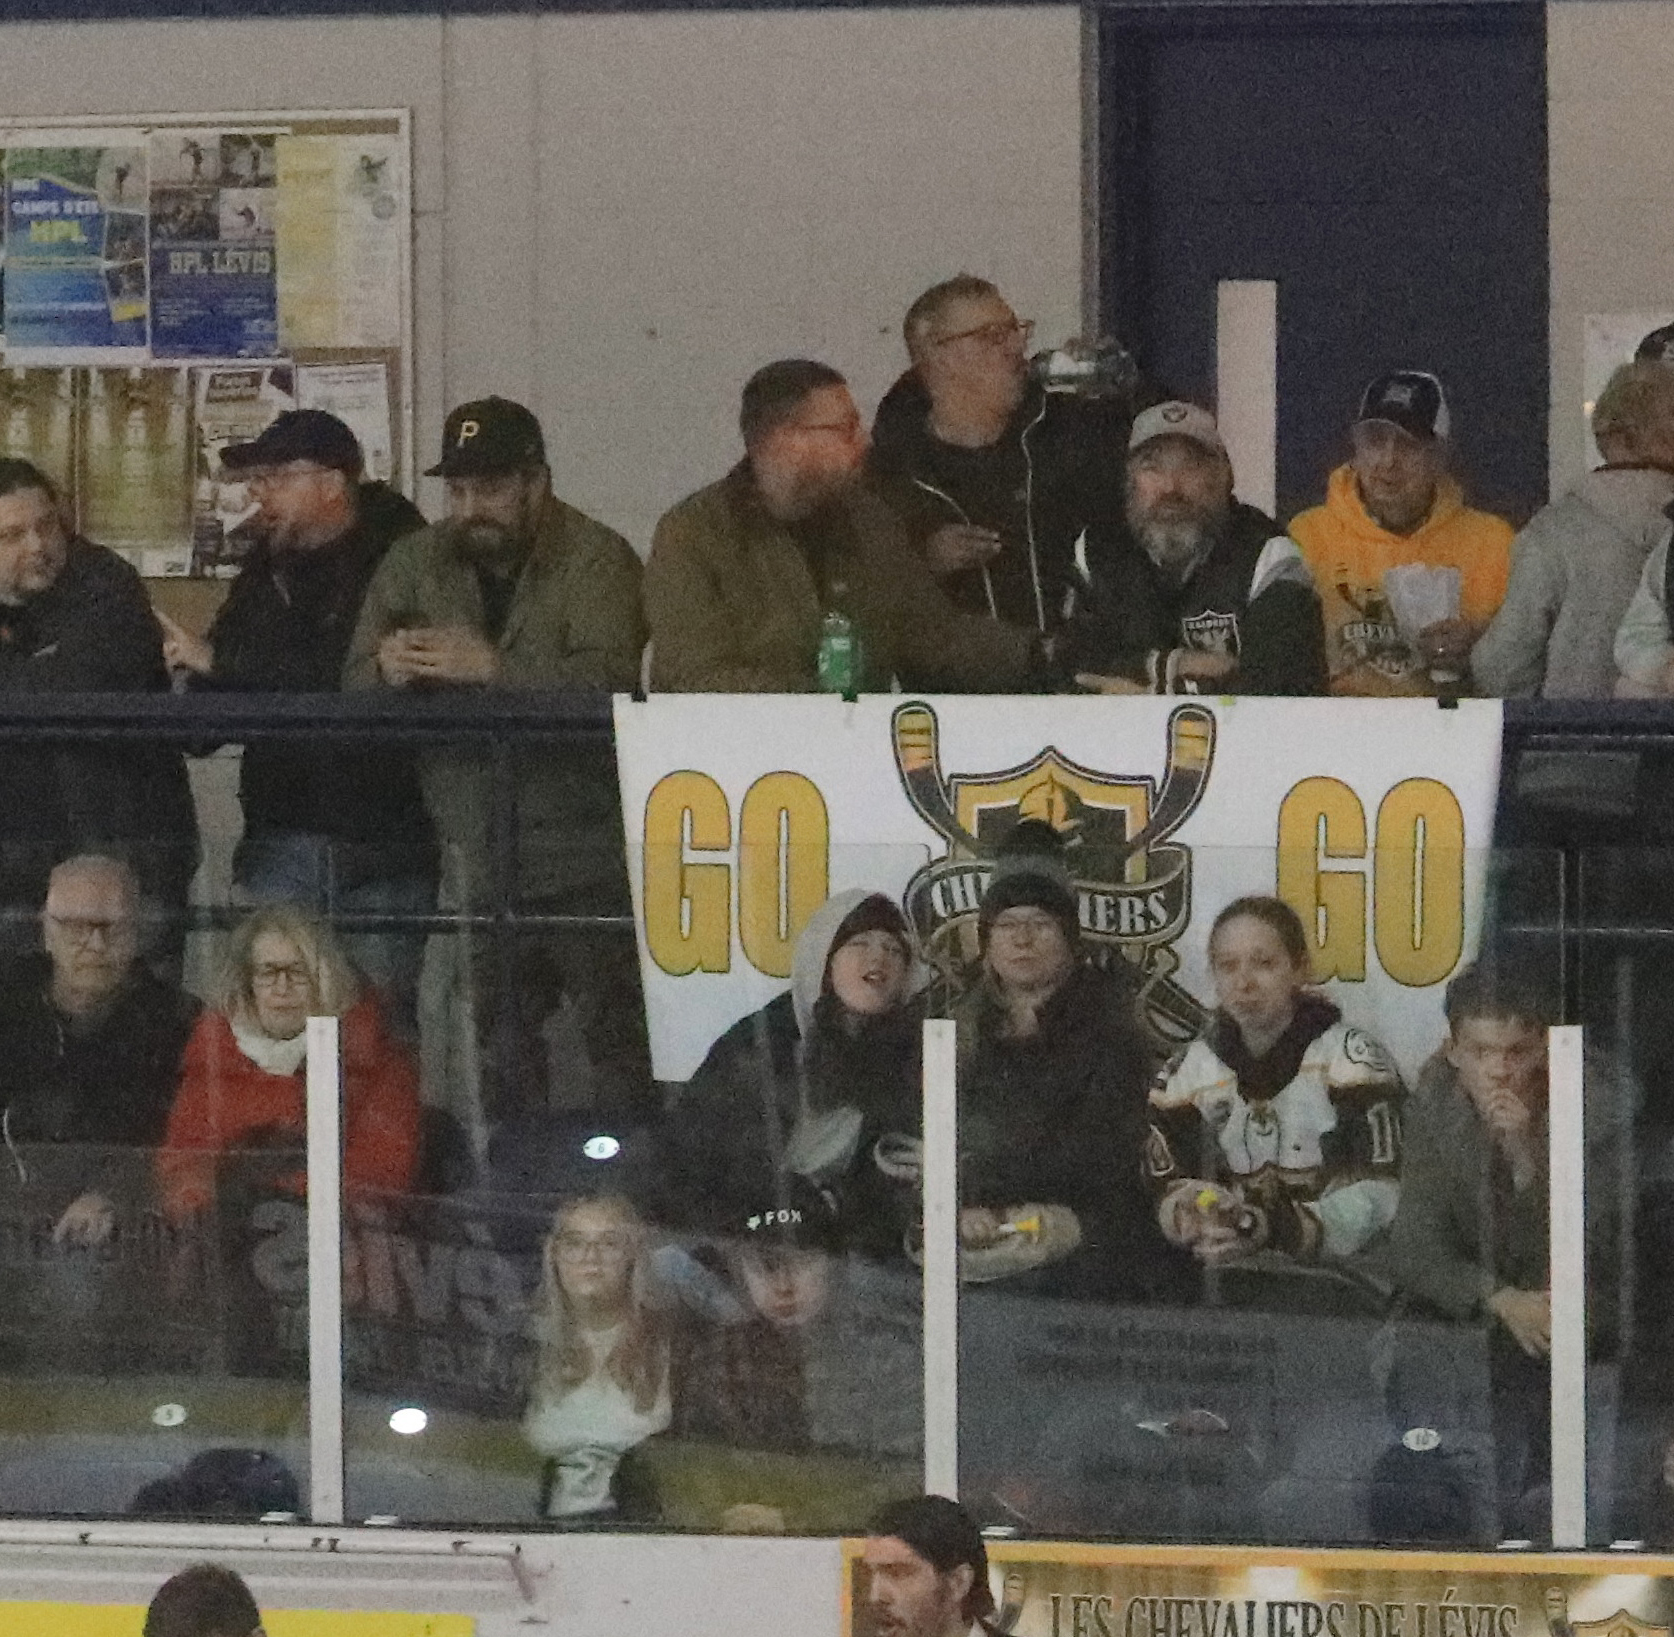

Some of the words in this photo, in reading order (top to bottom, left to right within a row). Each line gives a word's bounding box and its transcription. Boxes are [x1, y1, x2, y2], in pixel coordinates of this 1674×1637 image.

[458, 419, 481, 448] P
[642, 768, 830, 978] GO
[1275, 774, 1464, 987] GO
[765, 1209, 803, 1226] FOX
